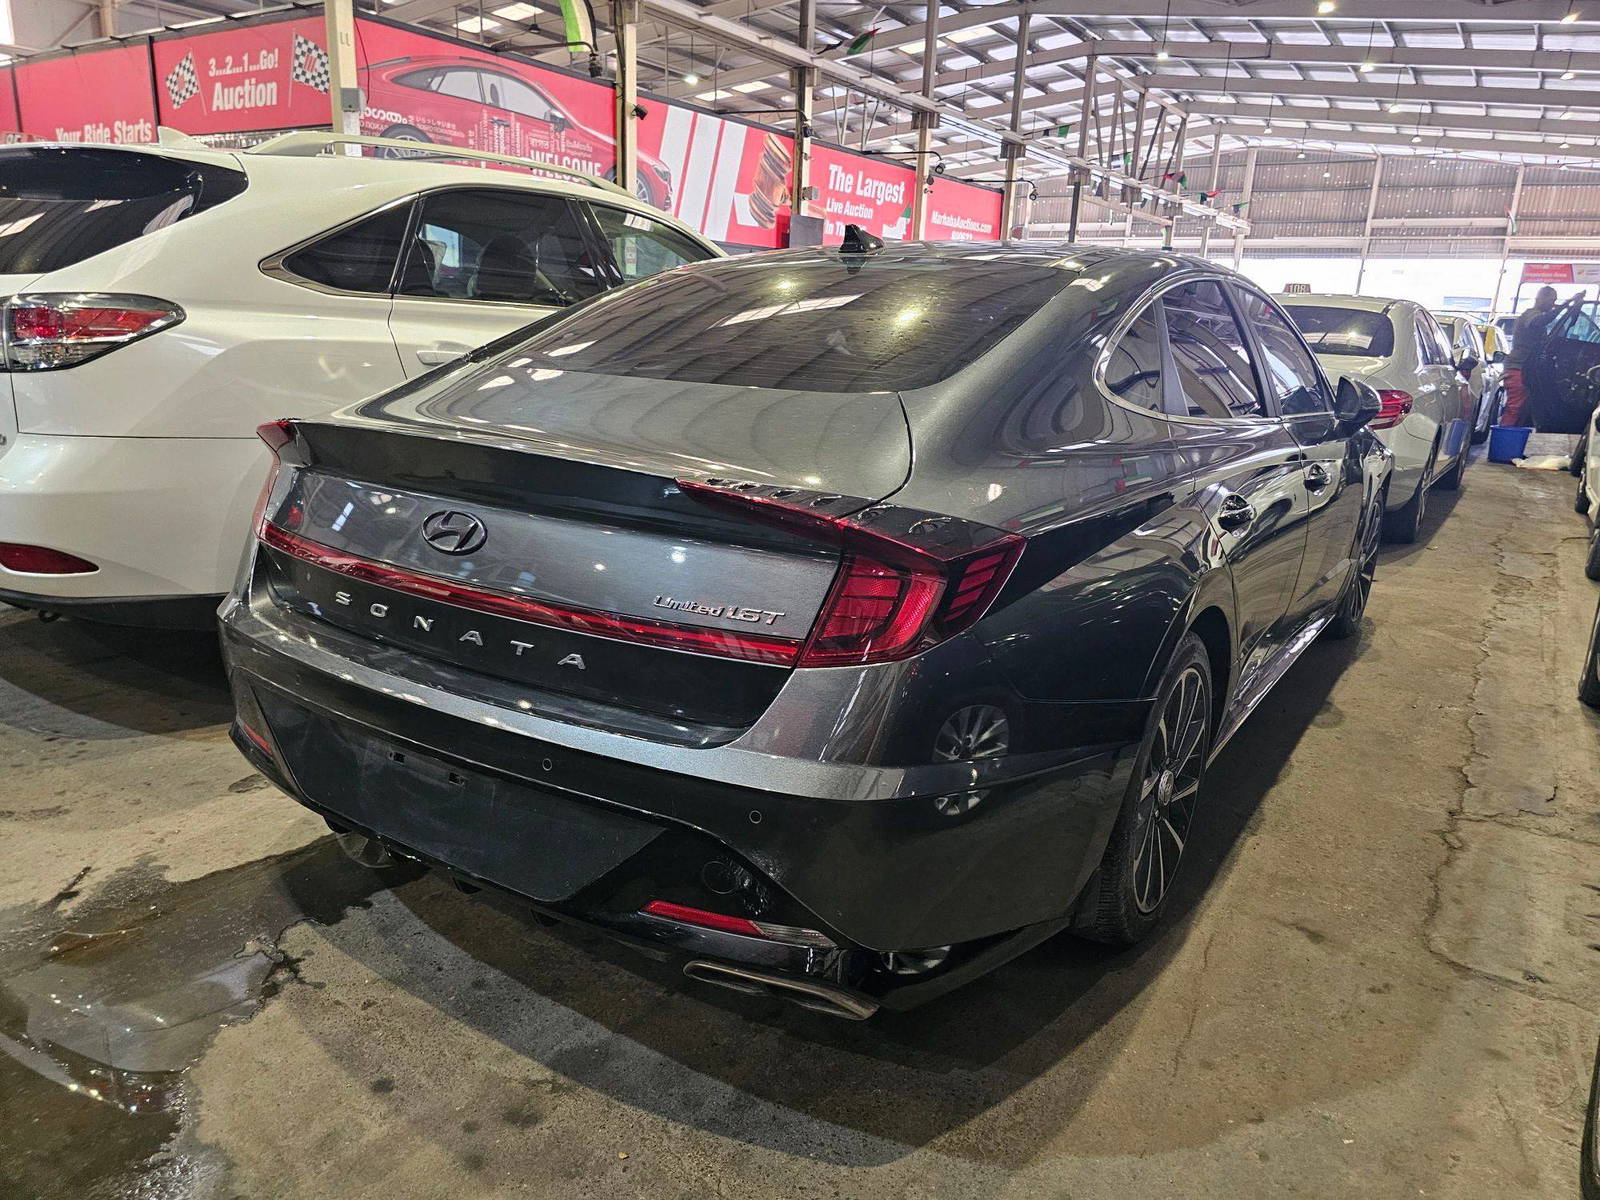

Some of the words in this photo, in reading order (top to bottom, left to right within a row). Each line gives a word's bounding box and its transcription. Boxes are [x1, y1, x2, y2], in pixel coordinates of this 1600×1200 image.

[211, 77, 278, 112] Auction
[55, 127, 82, 143] Your
[84, 122, 111, 143] Ride
[114, 118, 151, 143] Starts
[530, 149, 603, 182] WELCOME
[828, 163, 854, 194] The
[855, 170, 905, 206] Largest
[826, 197, 844, 215] Live
[843, 200, 874, 219] Auction
[653, 594, 726, 617] Limited
[335, 590, 587, 670] SONATA
